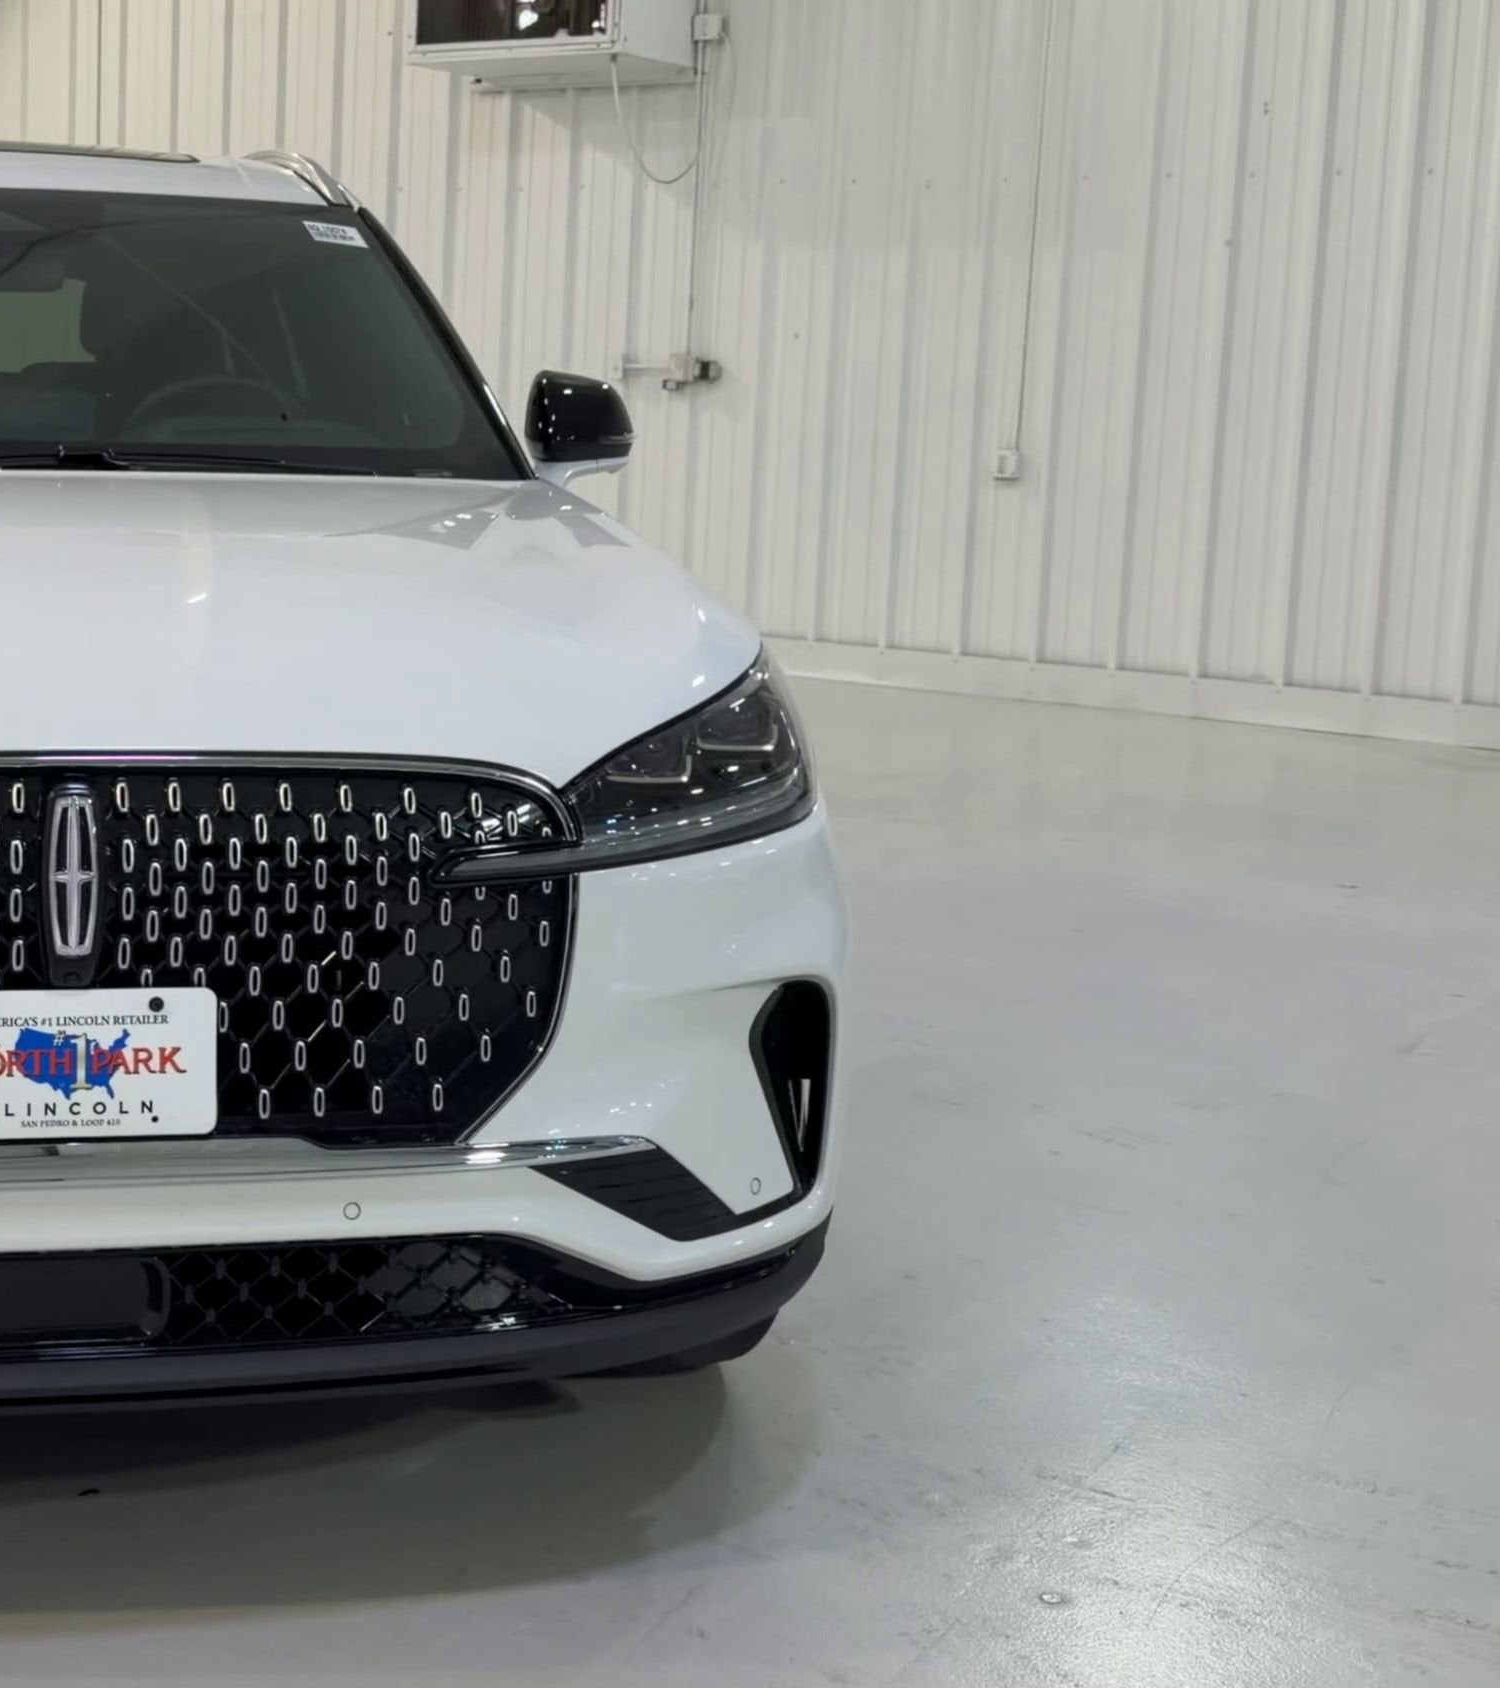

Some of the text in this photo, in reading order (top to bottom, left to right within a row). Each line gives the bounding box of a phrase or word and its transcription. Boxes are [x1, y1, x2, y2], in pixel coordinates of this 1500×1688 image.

[40, 1017, 53, 1027] #1
[56, 1015, 110, 1027] LINCOLN
[113, 1014, 170, 1025] RETAILER
[91, 1046, 187, 1075] PARK
[4, 1100, 153, 1117] LINCOLN
[21, 1120, 38, 1128] SAN
[40, 1119, 70, 1127] PEDRO
[81, 1118, 105, 1126] LOOP
